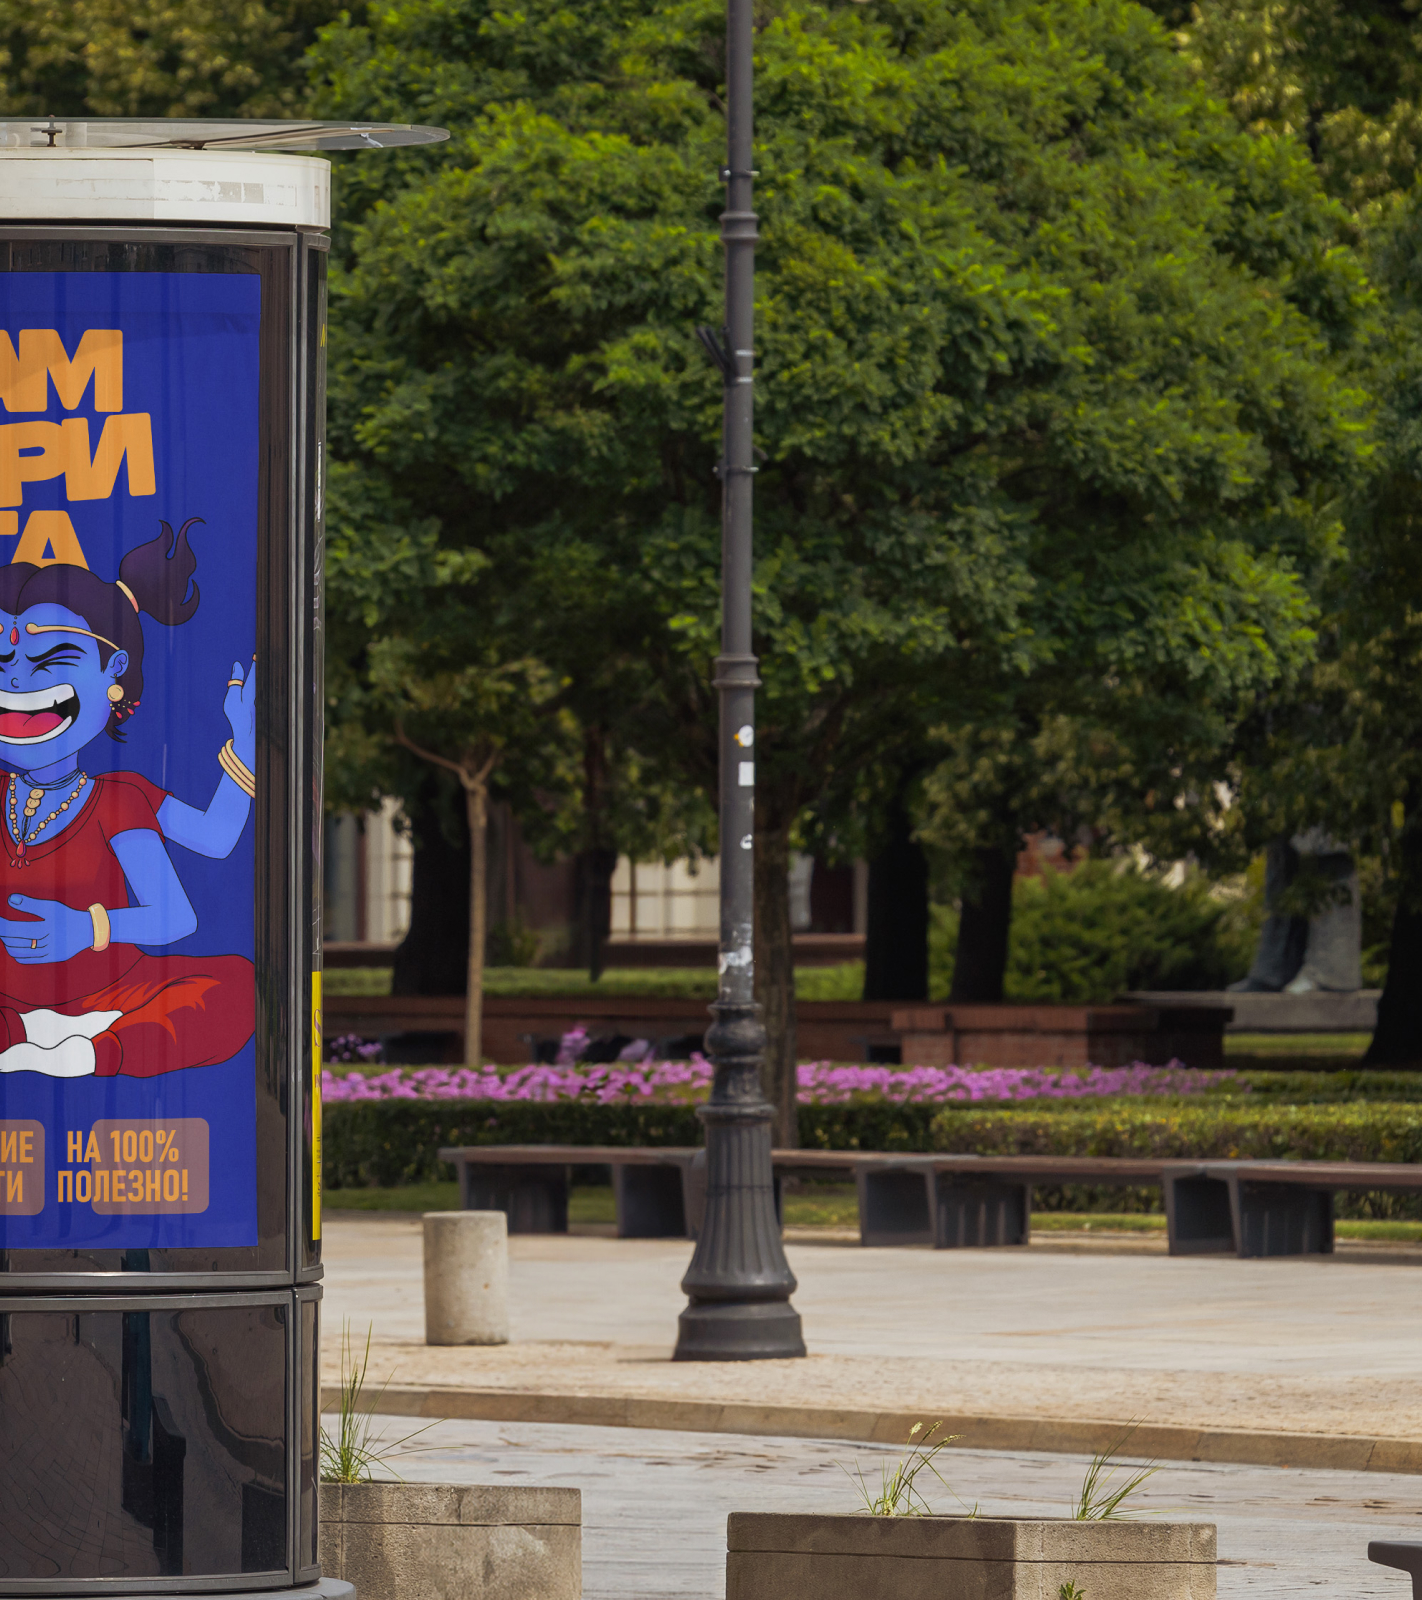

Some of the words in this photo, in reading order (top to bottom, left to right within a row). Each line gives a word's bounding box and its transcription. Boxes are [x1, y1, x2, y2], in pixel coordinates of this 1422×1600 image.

[67, 1130, 101, 1163] НА
[110, 1130, 180, 1163] 100%
[57, 1169, 189, 1203] ПОЛЕЗНО!
